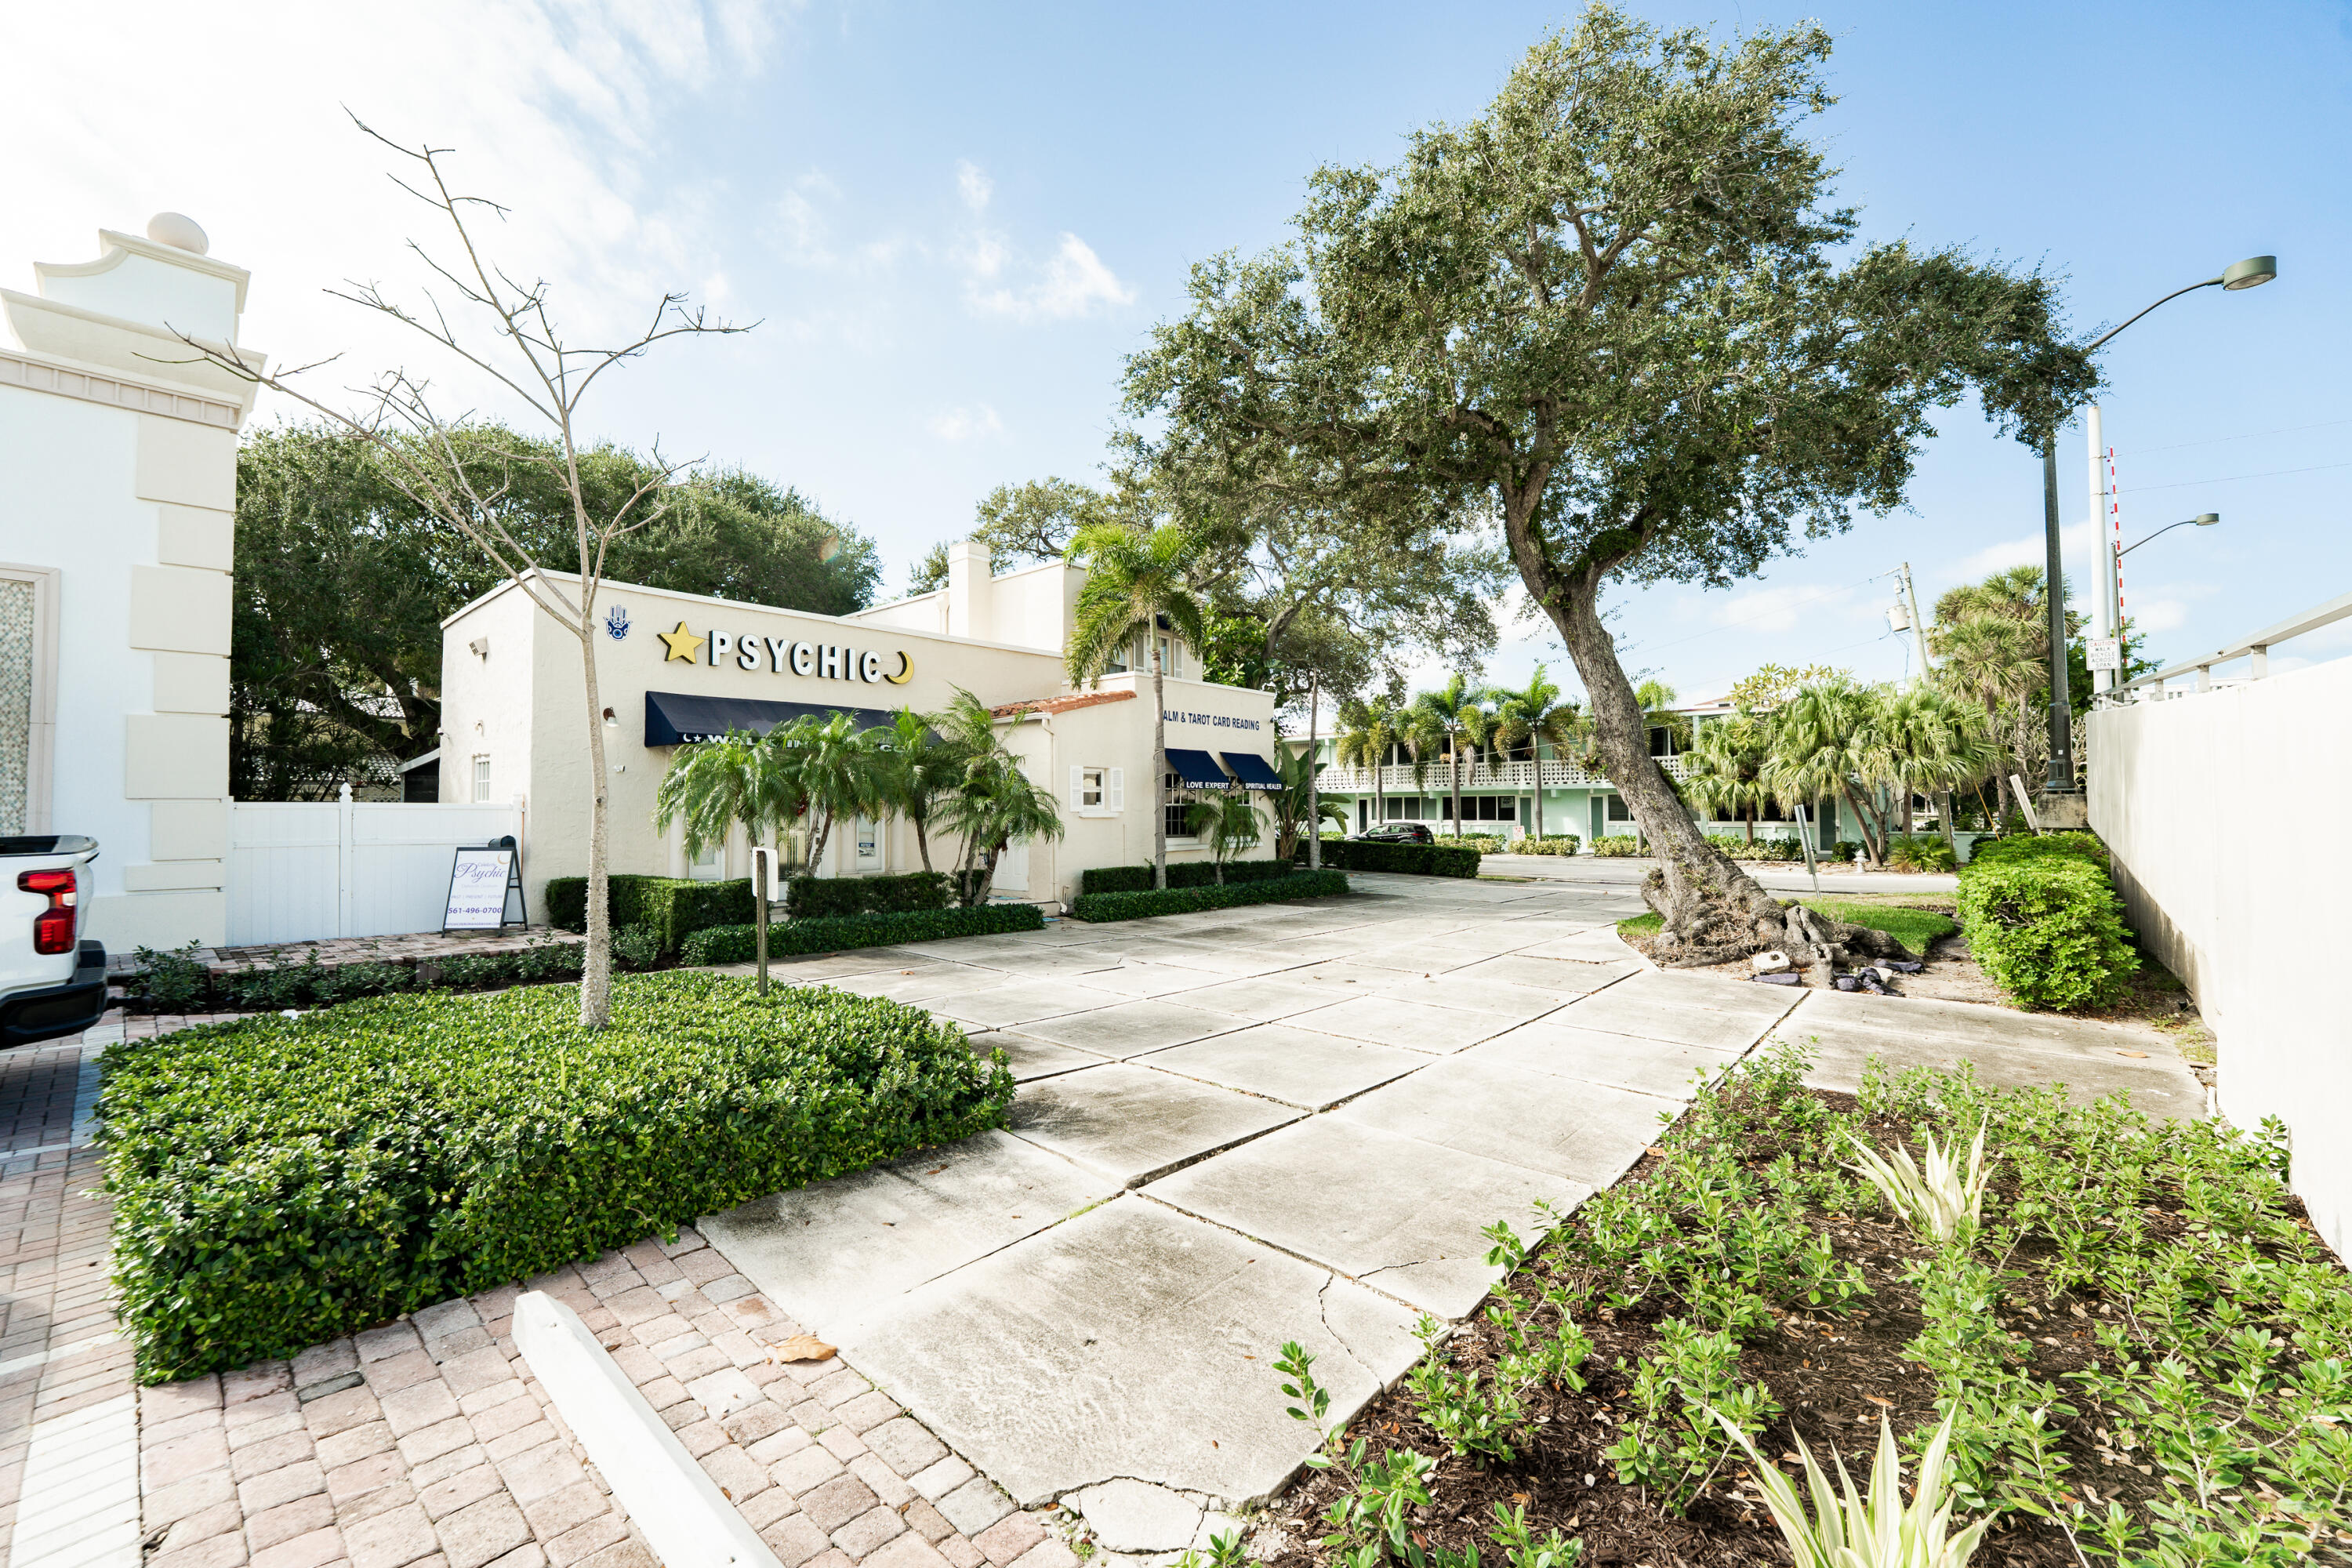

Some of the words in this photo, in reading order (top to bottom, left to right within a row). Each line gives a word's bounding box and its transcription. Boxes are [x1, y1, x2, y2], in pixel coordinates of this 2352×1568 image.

[708, 630, 882, 684] PSYCHIC
[1163, 710, 1178, 722] ALM
[1181, 712, 1185, 723] &
[1189, 713, 1210, 725] TAROT
[1213, 716, 1230, 728] CARD
[1232, 717, 1260, 731] READING
[454, 863, 506, 884] Psychic
